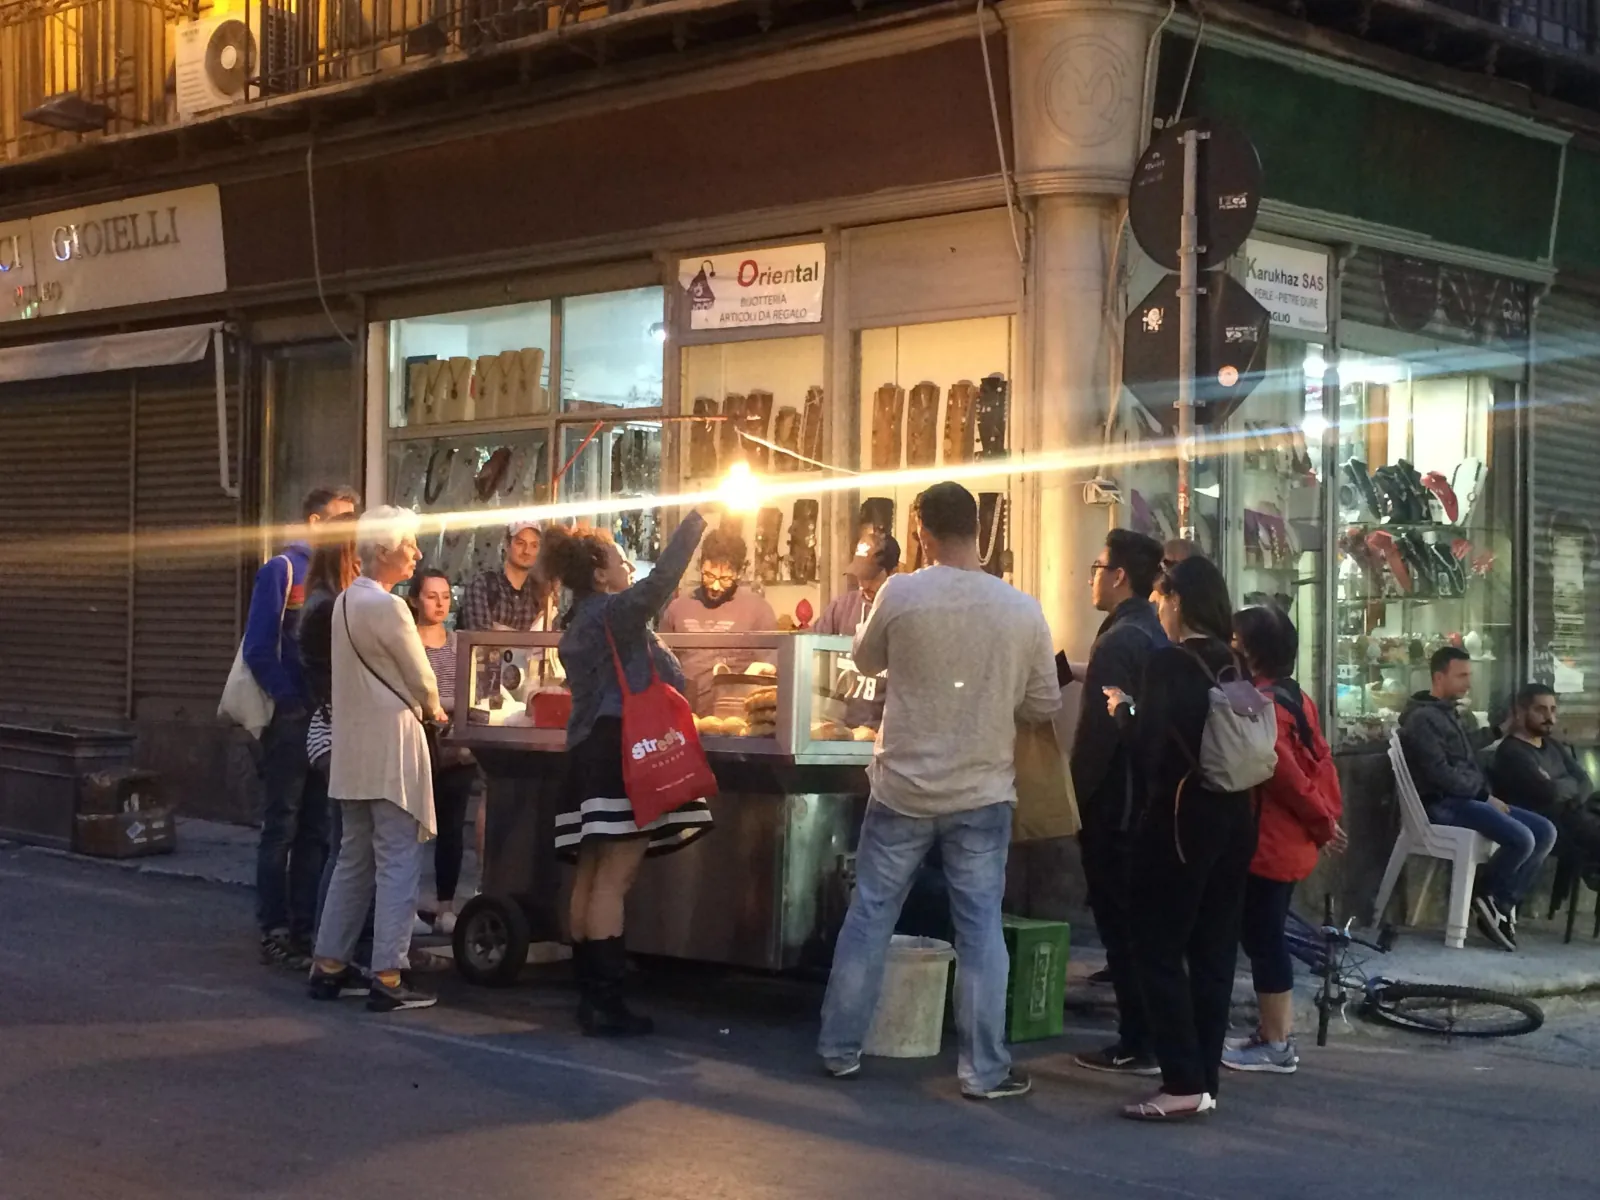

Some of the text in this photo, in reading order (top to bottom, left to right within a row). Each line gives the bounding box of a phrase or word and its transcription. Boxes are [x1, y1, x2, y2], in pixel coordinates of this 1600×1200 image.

[51, 206, 181, 262] GIOIELLI
[737, 259, 819, 287] Oriental
[1246, 257, 1324, 291] Karukhaz SAS
[758, 310, 772, 322] DA
[773, 308, 807, 320] REGALO
[852, 675, 877, 701] 78
